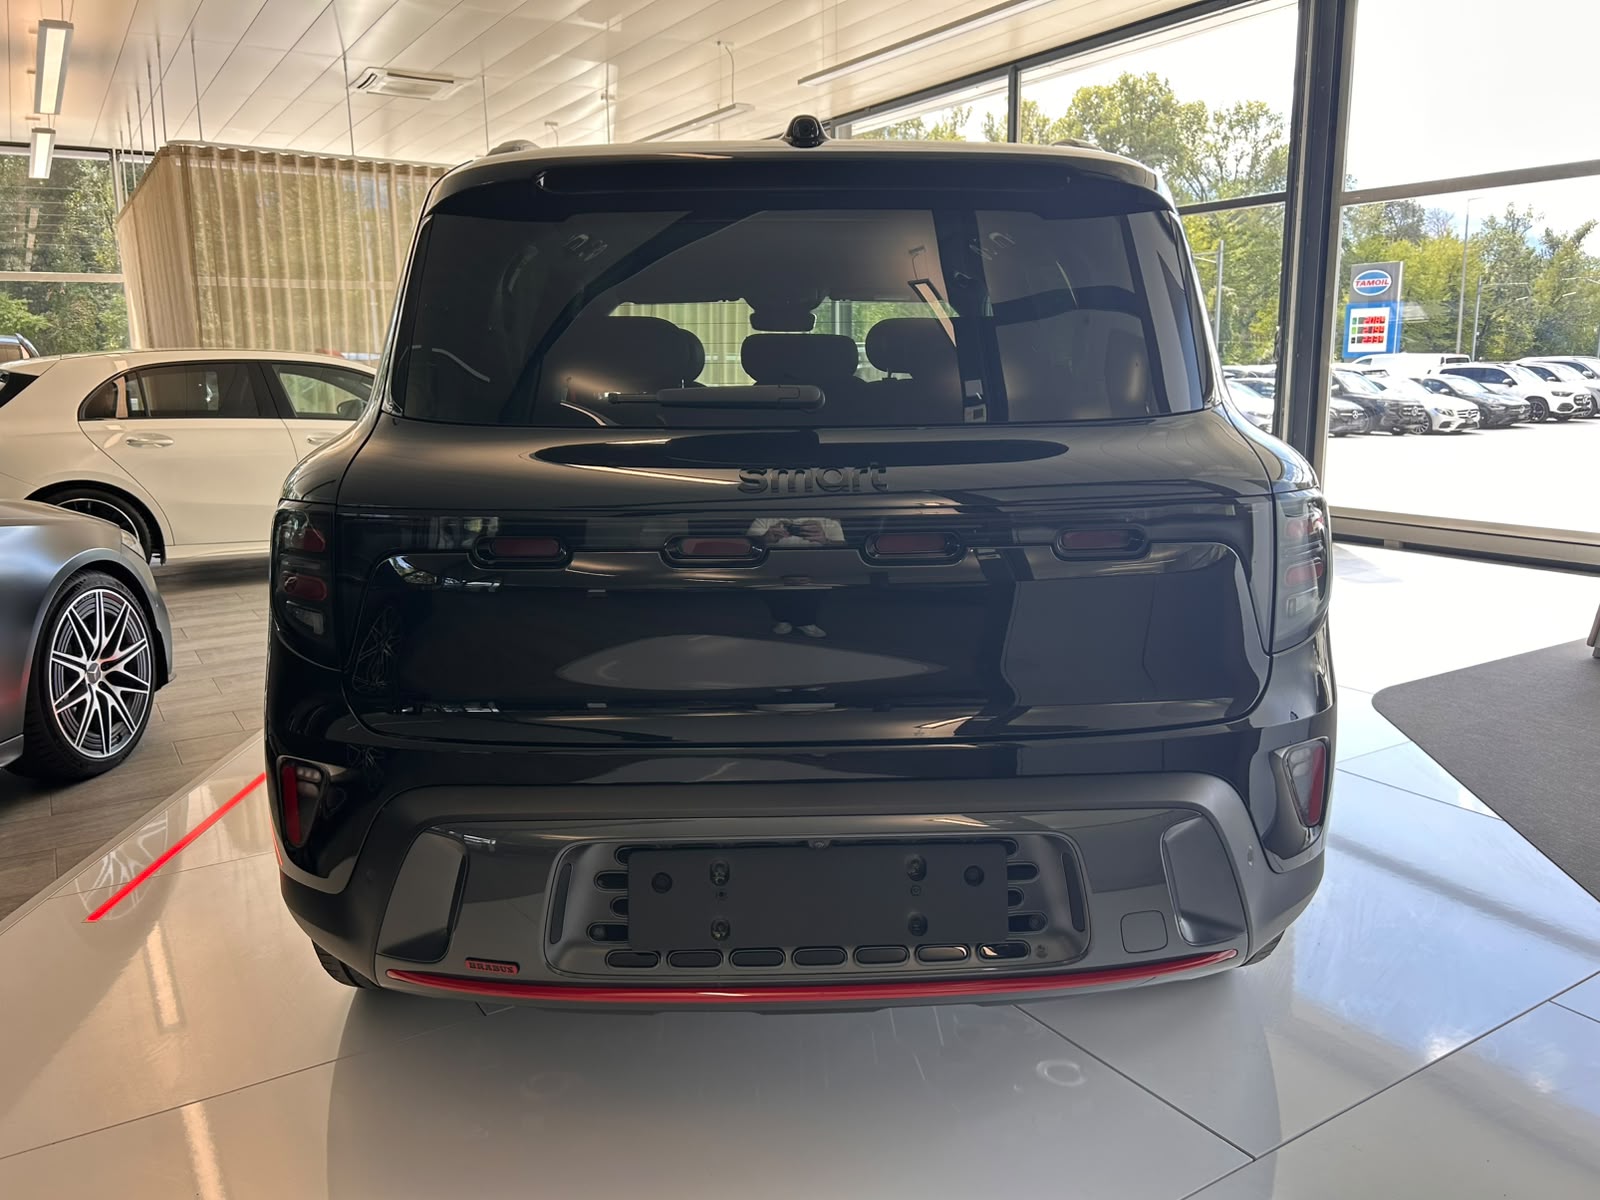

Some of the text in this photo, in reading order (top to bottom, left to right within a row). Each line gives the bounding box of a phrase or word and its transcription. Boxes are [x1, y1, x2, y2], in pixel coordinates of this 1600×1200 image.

[1355, 279, 1389, 287] TAMOIL
[737, 463, 888, 494] smart
[469, 961, 514, 973] BRABUS
